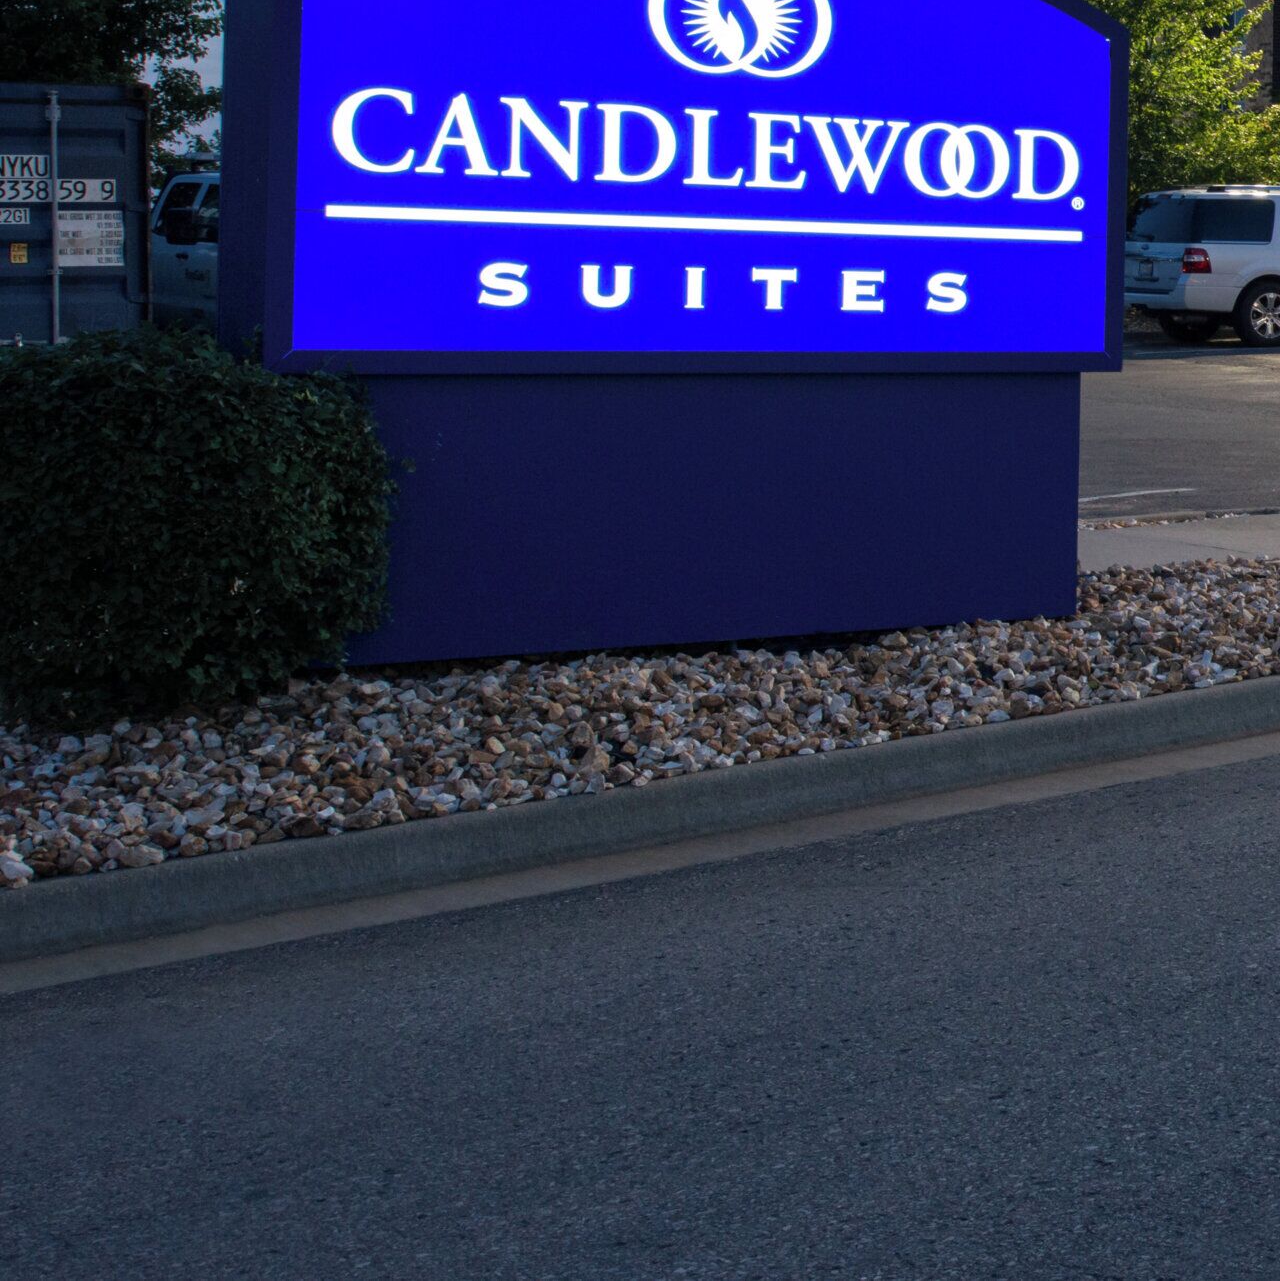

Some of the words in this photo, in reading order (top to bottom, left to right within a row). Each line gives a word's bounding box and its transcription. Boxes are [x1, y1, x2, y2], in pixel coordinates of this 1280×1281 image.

[331, 86, 1083, 202] CANDLEWOOD
[101, 180, 114, 200] 9
[0, 209, 28, 223] 2G1
[477, 262, 967, 314] SUITES
